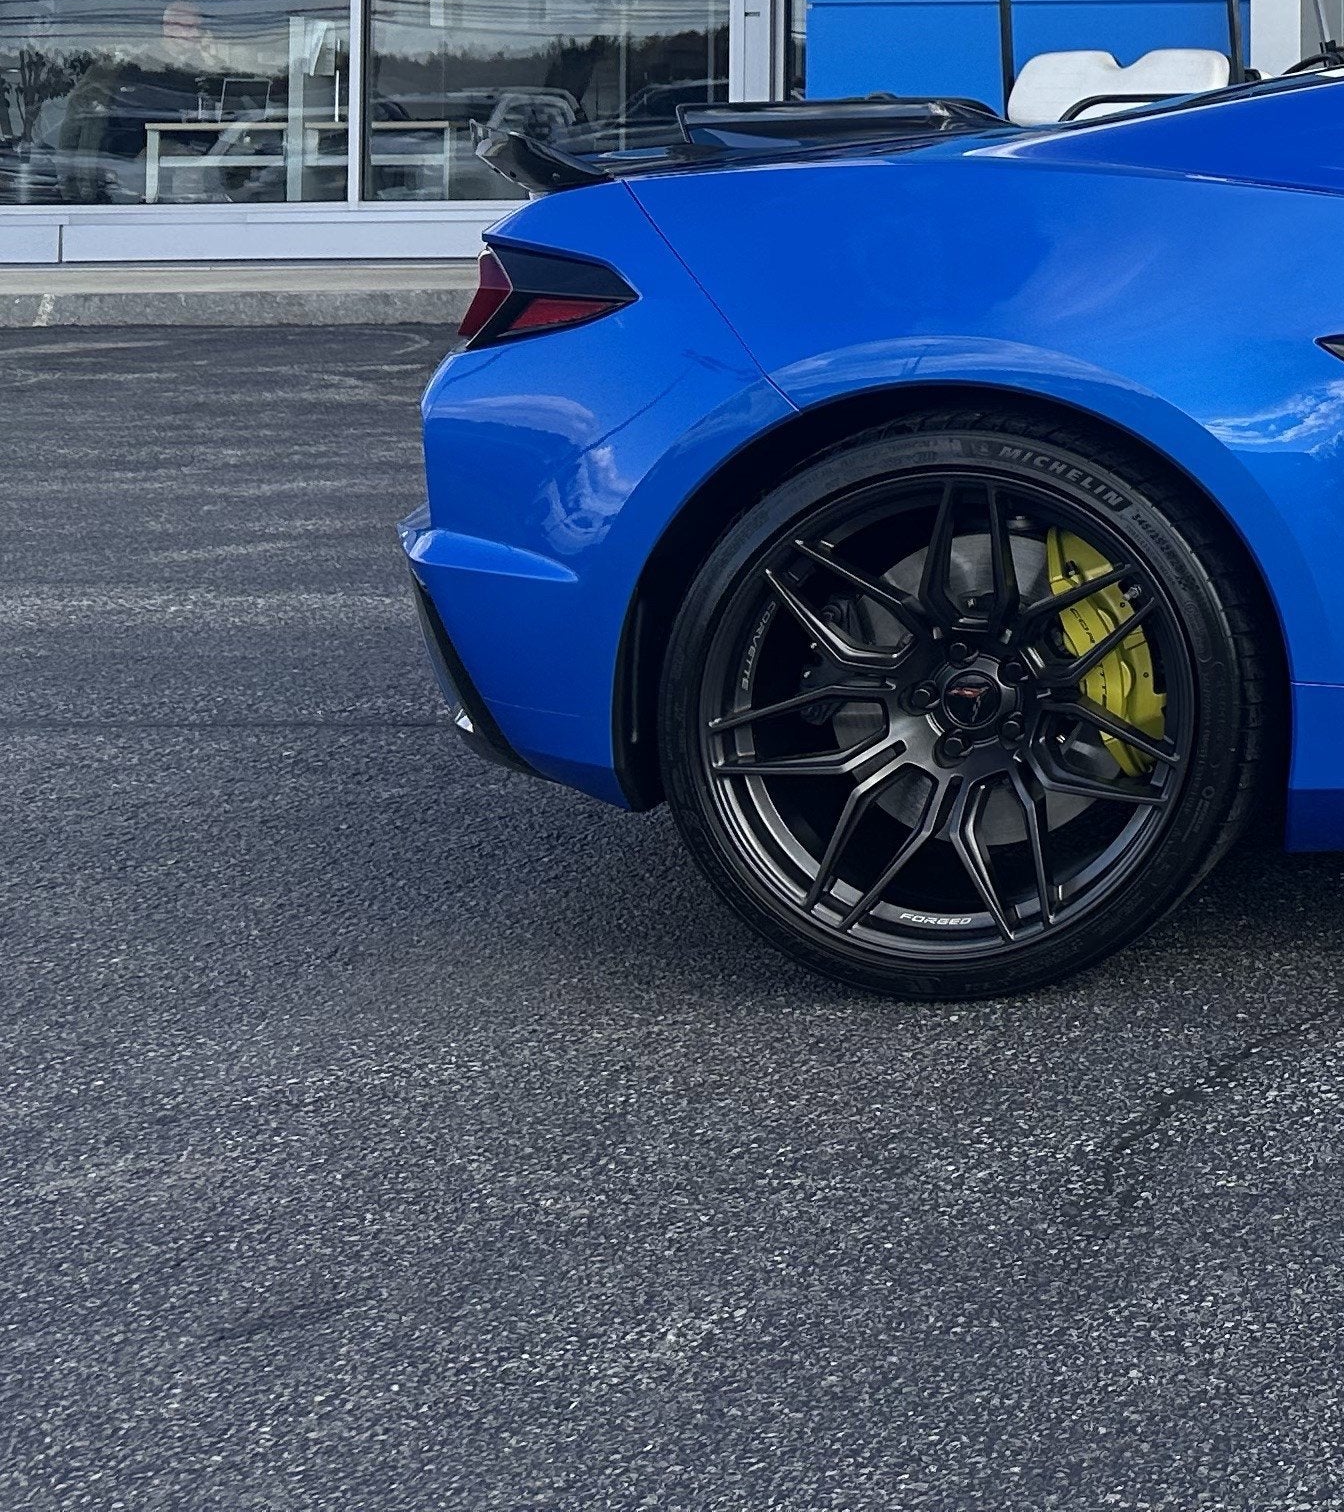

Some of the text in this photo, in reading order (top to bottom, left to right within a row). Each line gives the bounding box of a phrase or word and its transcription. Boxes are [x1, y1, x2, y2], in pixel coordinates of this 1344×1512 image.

[997, 446, 1124, 508] MICHELIN
[741, 600, 777, 691] CORVETTE
[899, 912, 973, 925] FORGED
